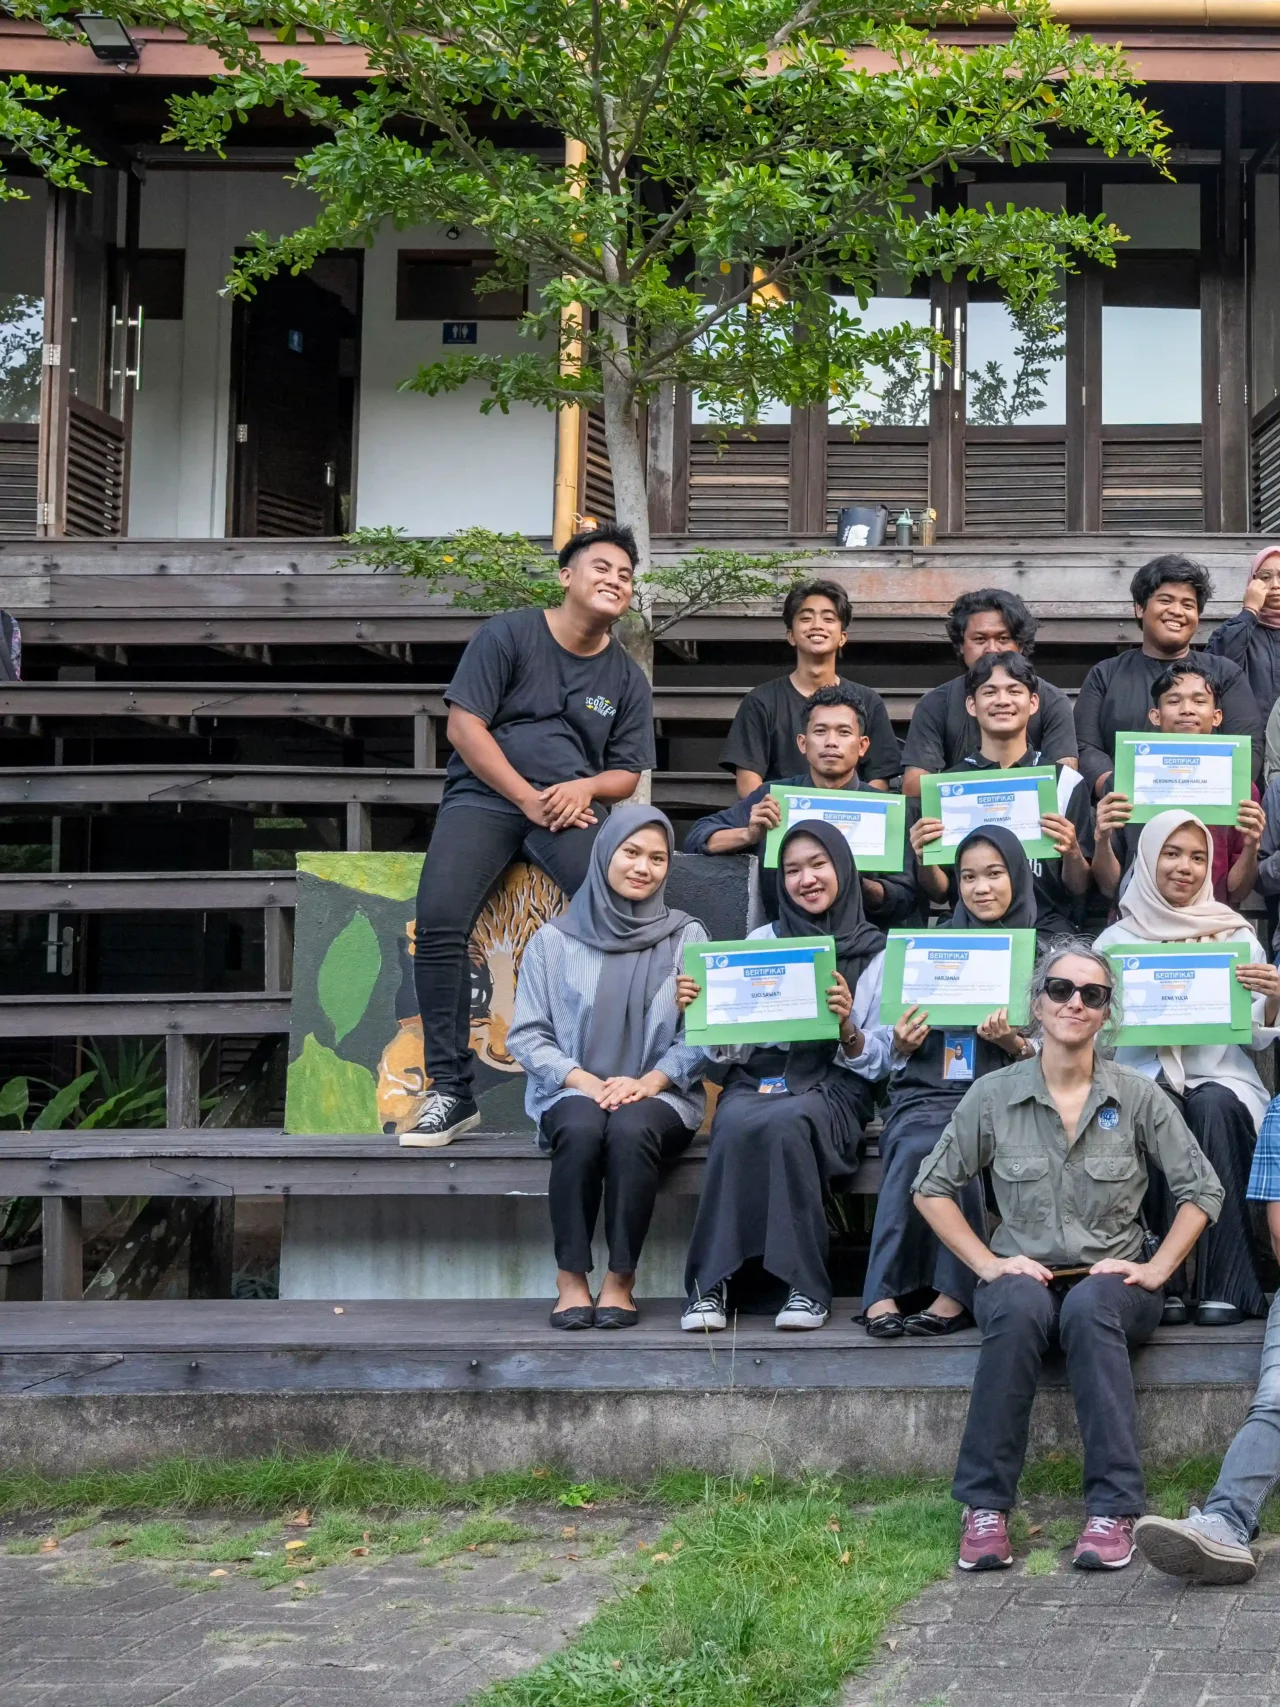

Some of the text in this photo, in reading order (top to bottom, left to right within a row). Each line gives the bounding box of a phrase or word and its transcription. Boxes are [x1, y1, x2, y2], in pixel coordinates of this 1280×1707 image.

[585, 697, 617, 717] SCOOTER
[1163, 757, 1200, 766] SERTIFIKAT
[977, 794, 1015, 804] SERTIFIKAT
[824, 812, 860, 821] SERTIFIKAT
[929, 952, 969, 960] SERTIFIKAT
[744, 966, 785, 977] SERTIFIKAT
[1154, 971, 1195, 980] SERTIFIKAT
